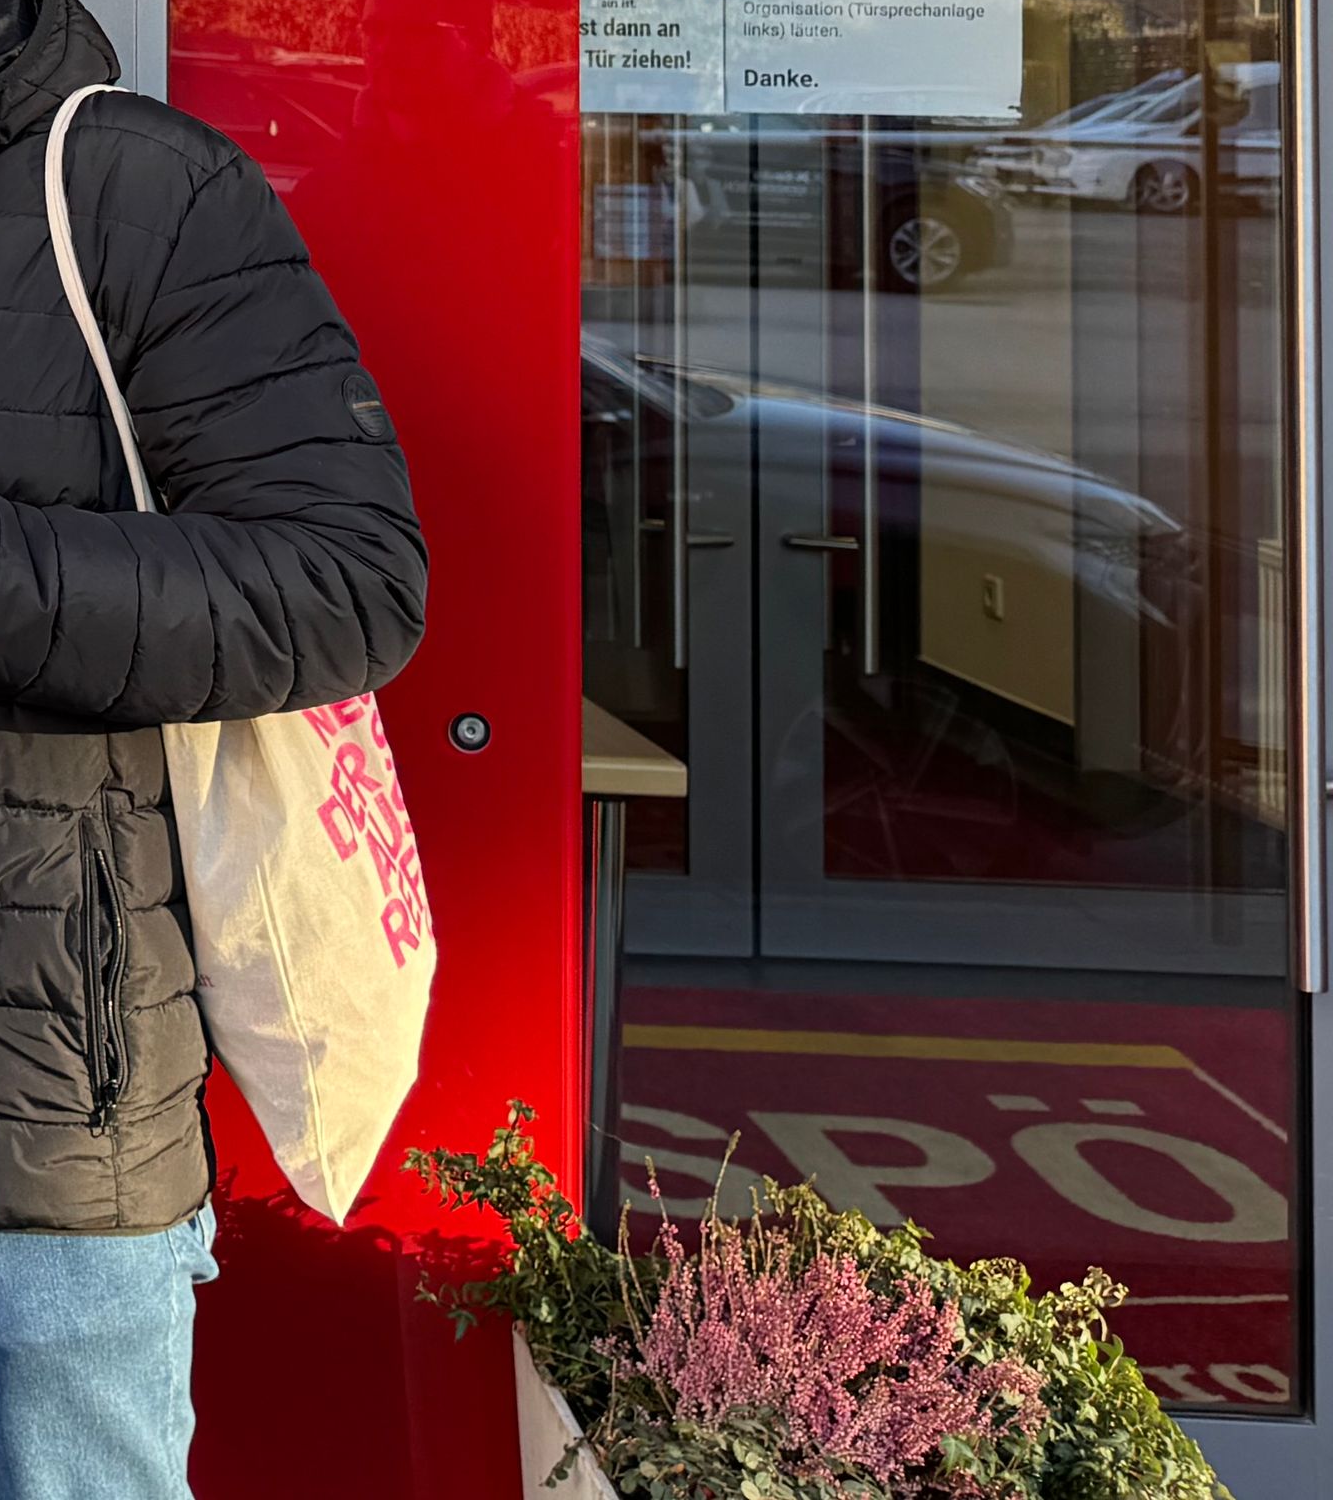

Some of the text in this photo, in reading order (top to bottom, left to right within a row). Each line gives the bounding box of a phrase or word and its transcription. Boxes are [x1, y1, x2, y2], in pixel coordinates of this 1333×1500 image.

[742, 1, 986, 21] Organisation (Türsprechanlage
[579, 17, 681, 38] st dann an
[743, 23, 844, 40] links) läuten.
[584, 48, 692, 70] Tür ziehen!
[743, 68, 820, 89] Danke.
[619, 1094, 1290, 1244] SPÖ
